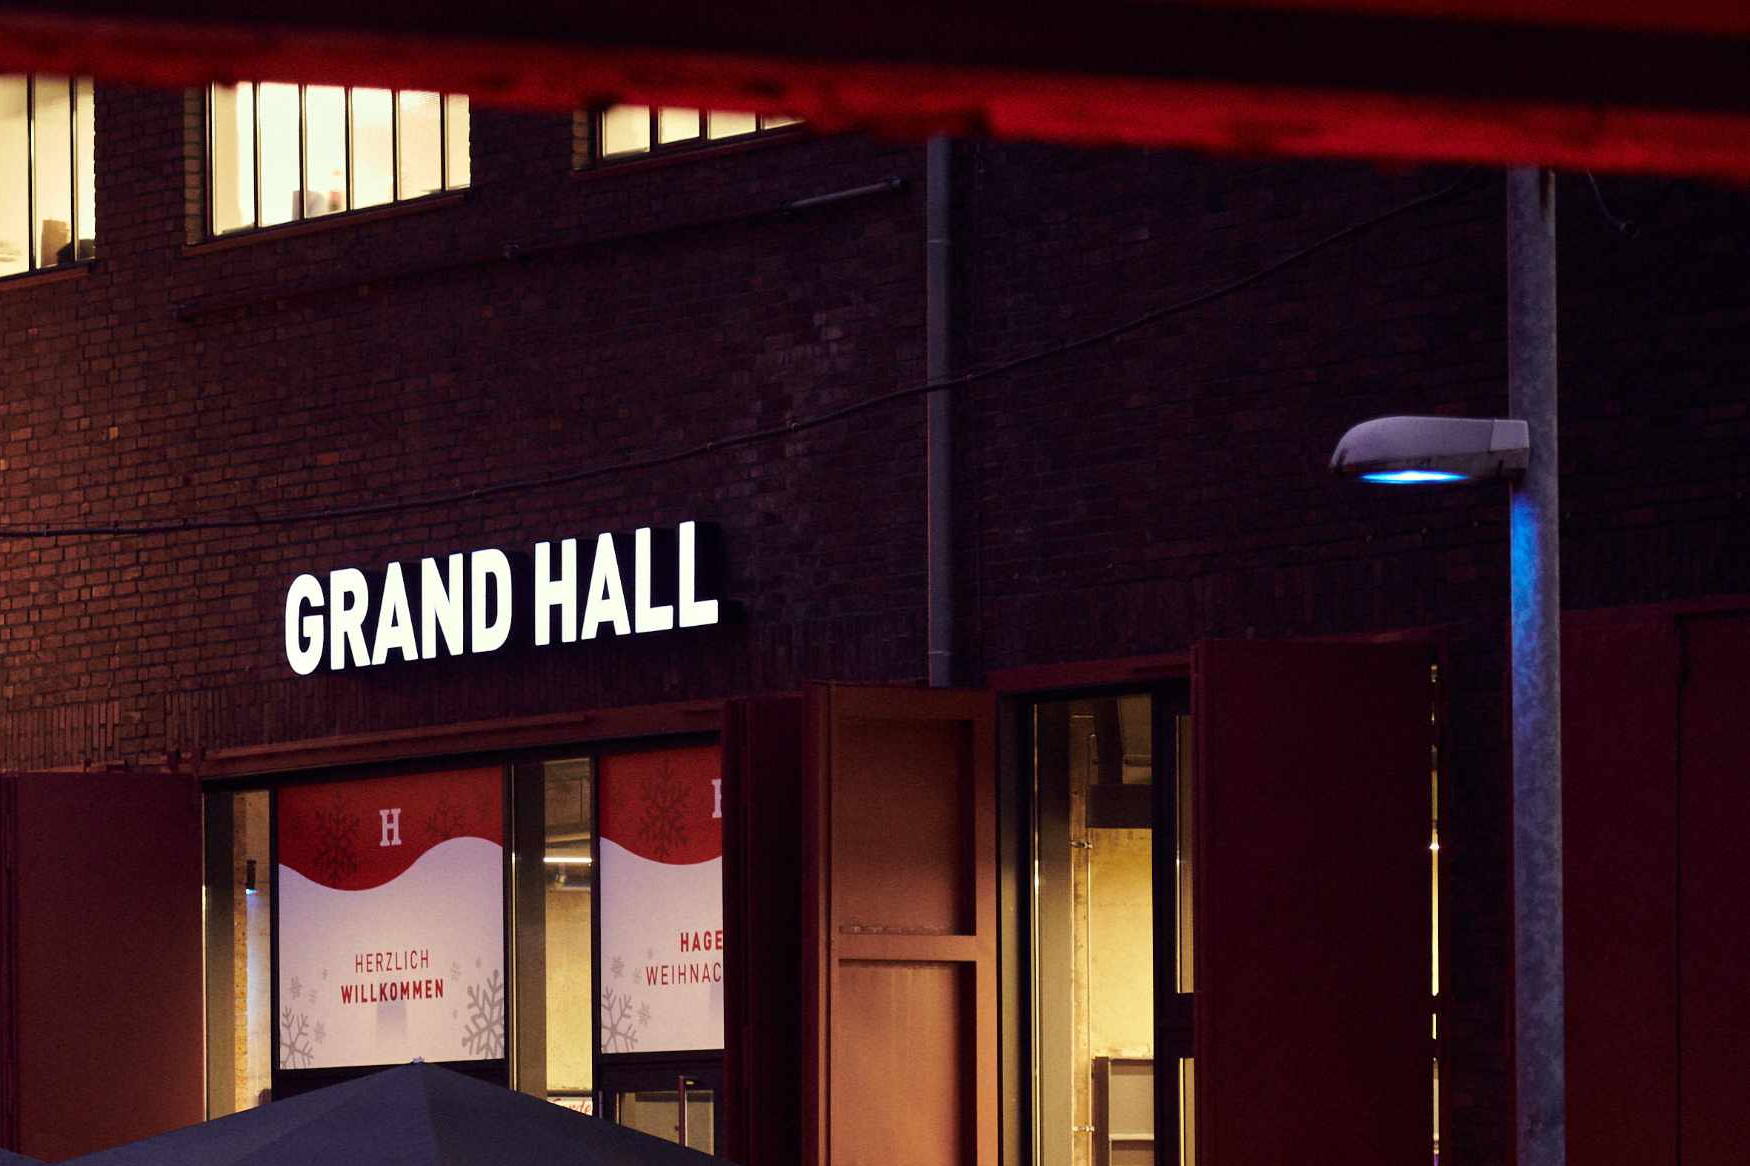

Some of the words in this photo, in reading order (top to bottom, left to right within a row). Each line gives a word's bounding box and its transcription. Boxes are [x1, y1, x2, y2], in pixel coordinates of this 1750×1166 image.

[284, 548, 513, 676] GRAND
[534, 520, 719, 646] HALL
[379, 807, 402, 847] H
[355, 949, 429, 973] HERZLICH
[341, 979, 443, 1004] WILLKOMMEN
